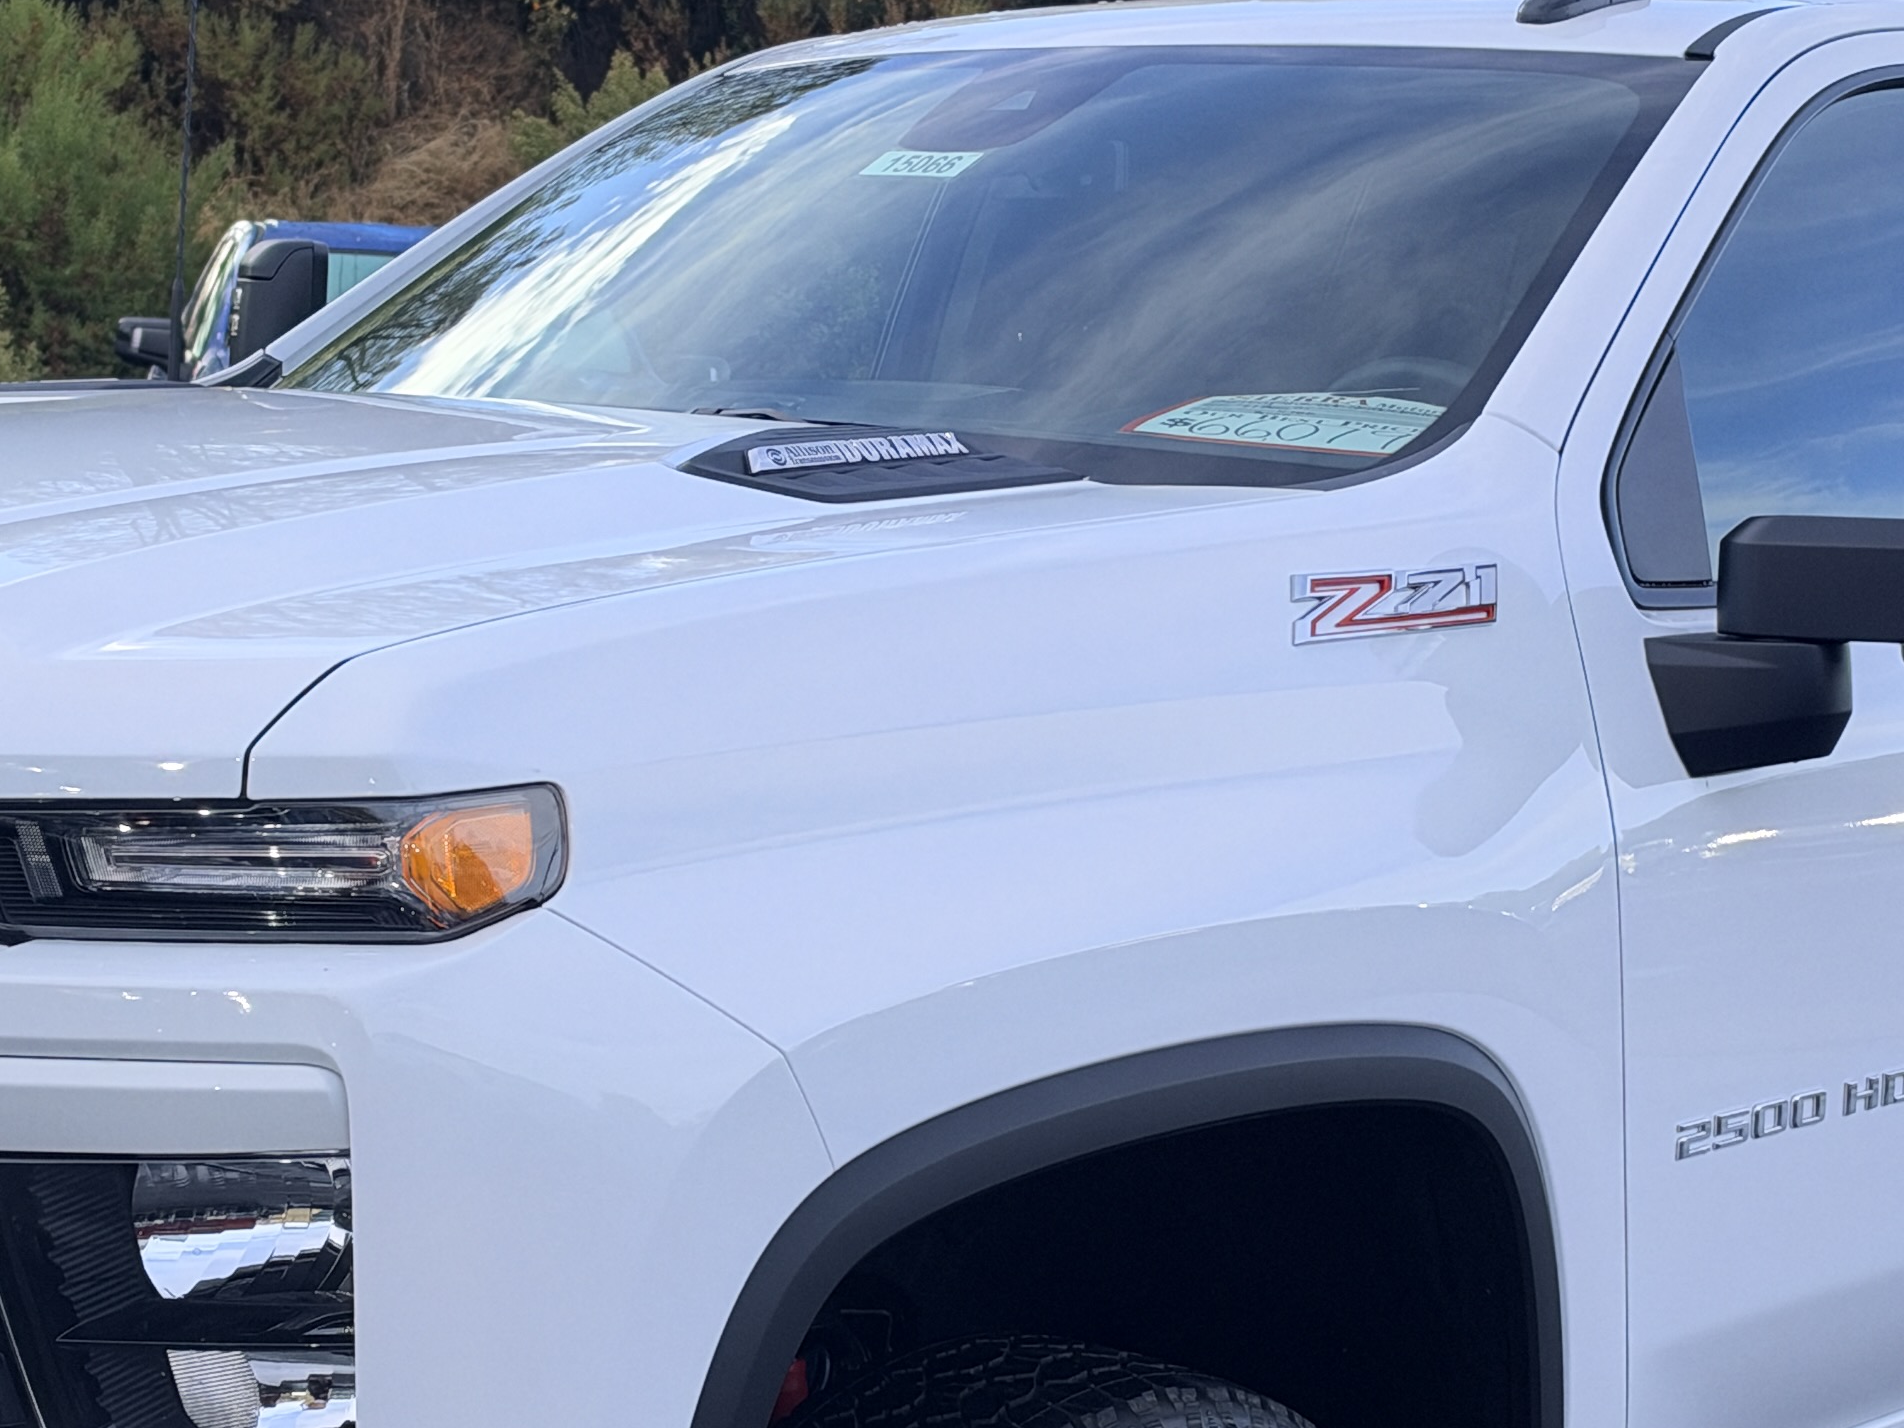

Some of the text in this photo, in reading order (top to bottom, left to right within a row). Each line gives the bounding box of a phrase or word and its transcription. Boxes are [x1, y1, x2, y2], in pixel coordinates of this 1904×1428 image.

[881, 154, 963, 173] 15066
[784, 444, 835, 458] Allison
[843, 432, 970, 464] DURAMAX
[1290, 564, 1498, 646] Z71
[1674, 1088, 1828, 1161] 2500
